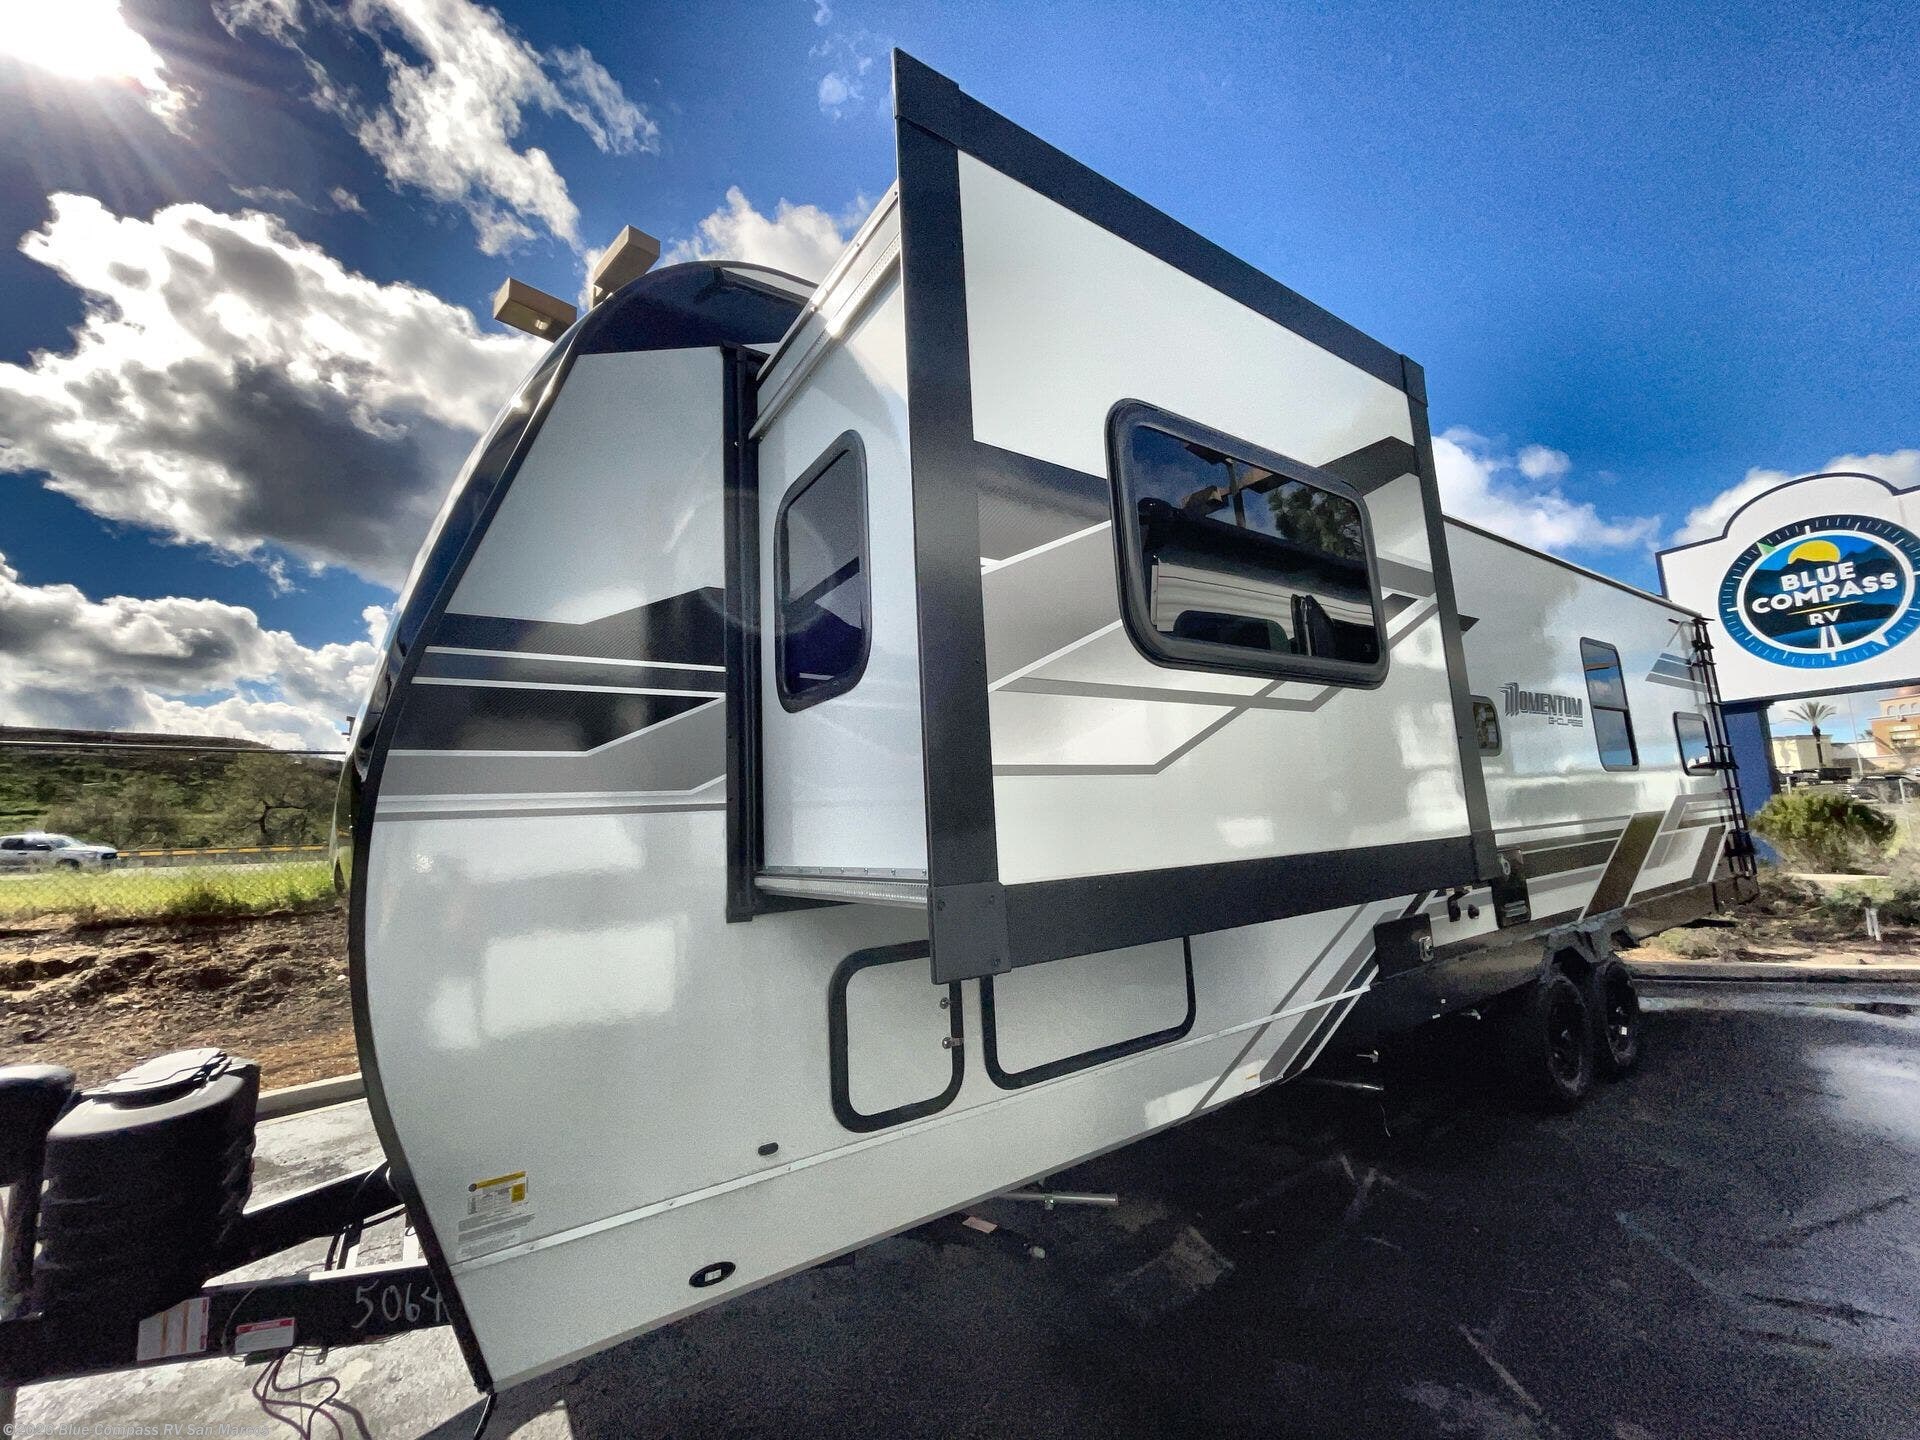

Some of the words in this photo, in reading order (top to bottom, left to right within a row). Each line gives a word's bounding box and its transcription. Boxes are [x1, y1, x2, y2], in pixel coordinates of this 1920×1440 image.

[1751, 572, 1898, 614] COMPASS
[1780, 561, 1856, 592] BLUE
[1808, 609, 1841, 626] RV
[1498, 682, 1583, 718] MOMENTUM
[351, 1279, 443, 1329] 5064
